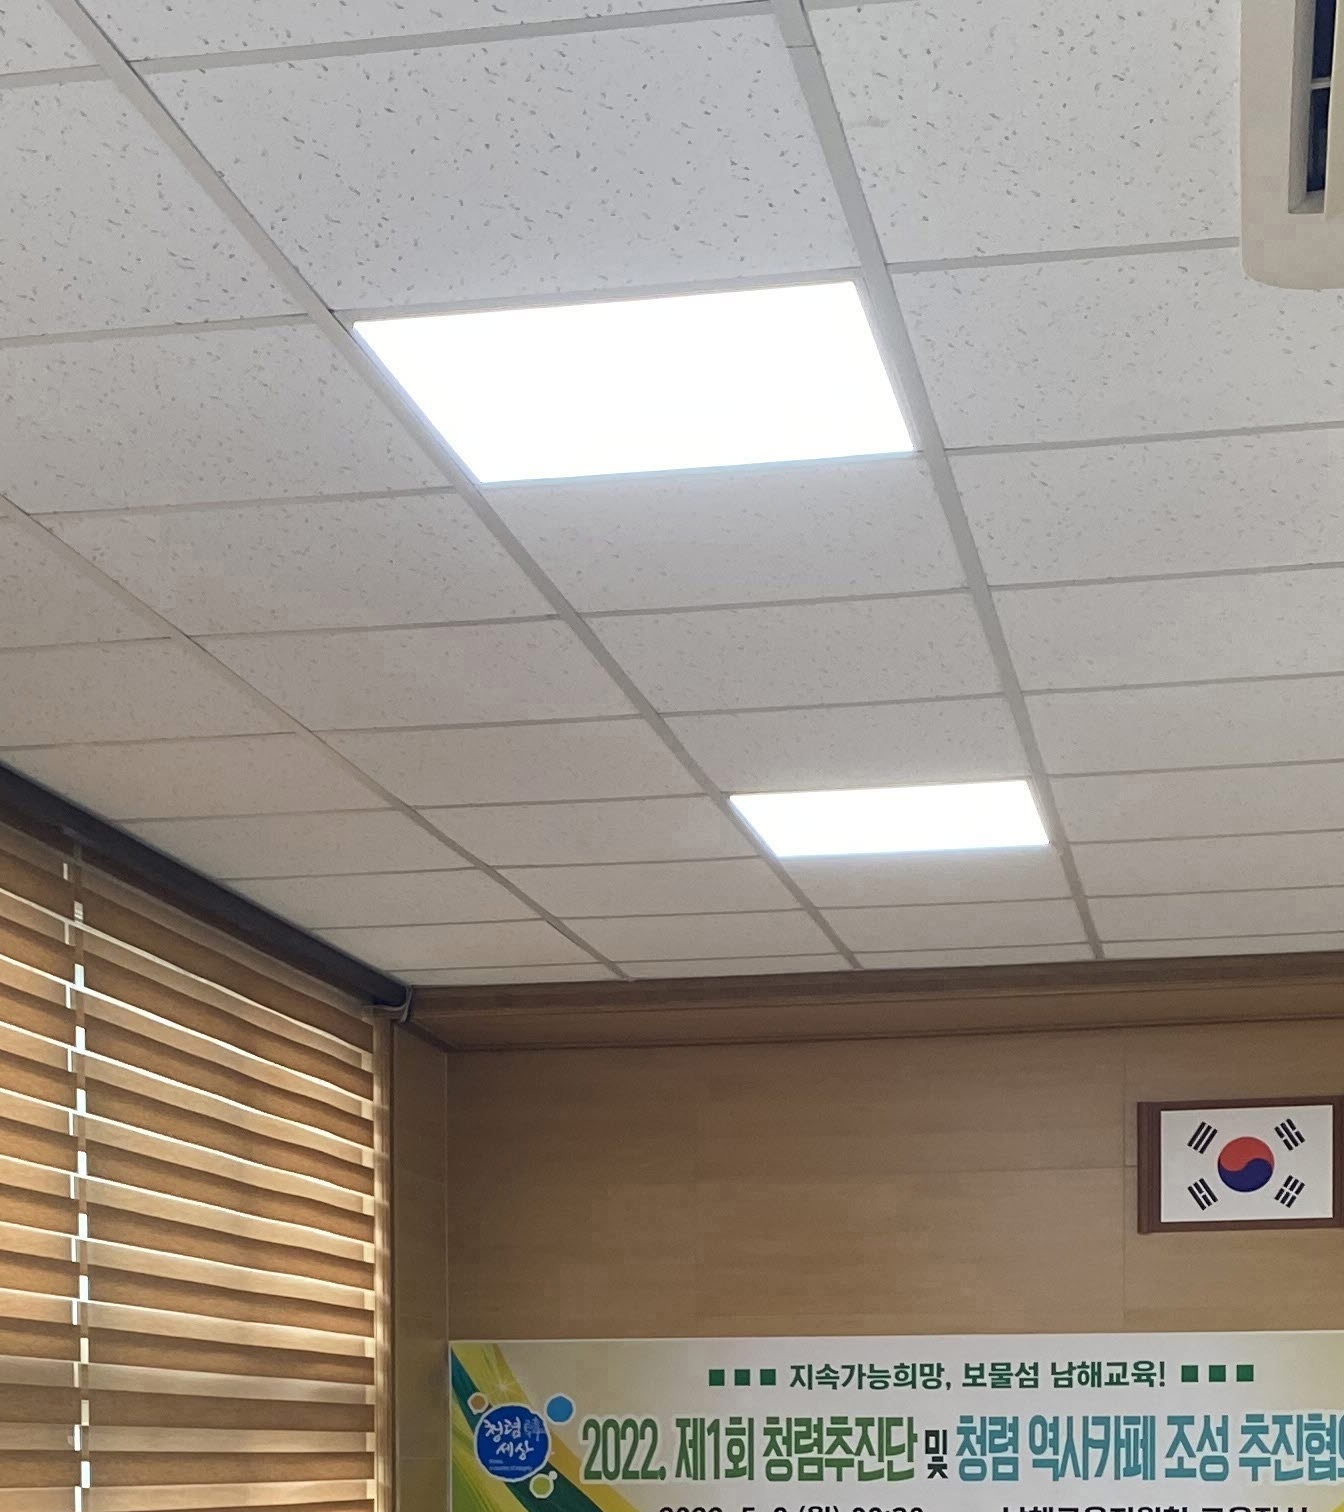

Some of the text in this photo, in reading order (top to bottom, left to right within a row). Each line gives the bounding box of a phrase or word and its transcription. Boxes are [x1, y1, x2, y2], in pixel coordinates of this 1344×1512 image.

[789, 1359, 1166, 1391] 지속가능희망, 보물섬 남해교육!
[581, 1417, 667, 1481] 2022.
[675, 1416, 755, 1482] 제1회
[762, 1415, 919, 1482] 청렴추진단
[924, 1428, 949, 1480] 및
[956, 1414, 1019, 1482] 청렴
[1028, 1413, 1156, 1482] 역사카페
[1164, 1413, 1230, 1482] 조성
